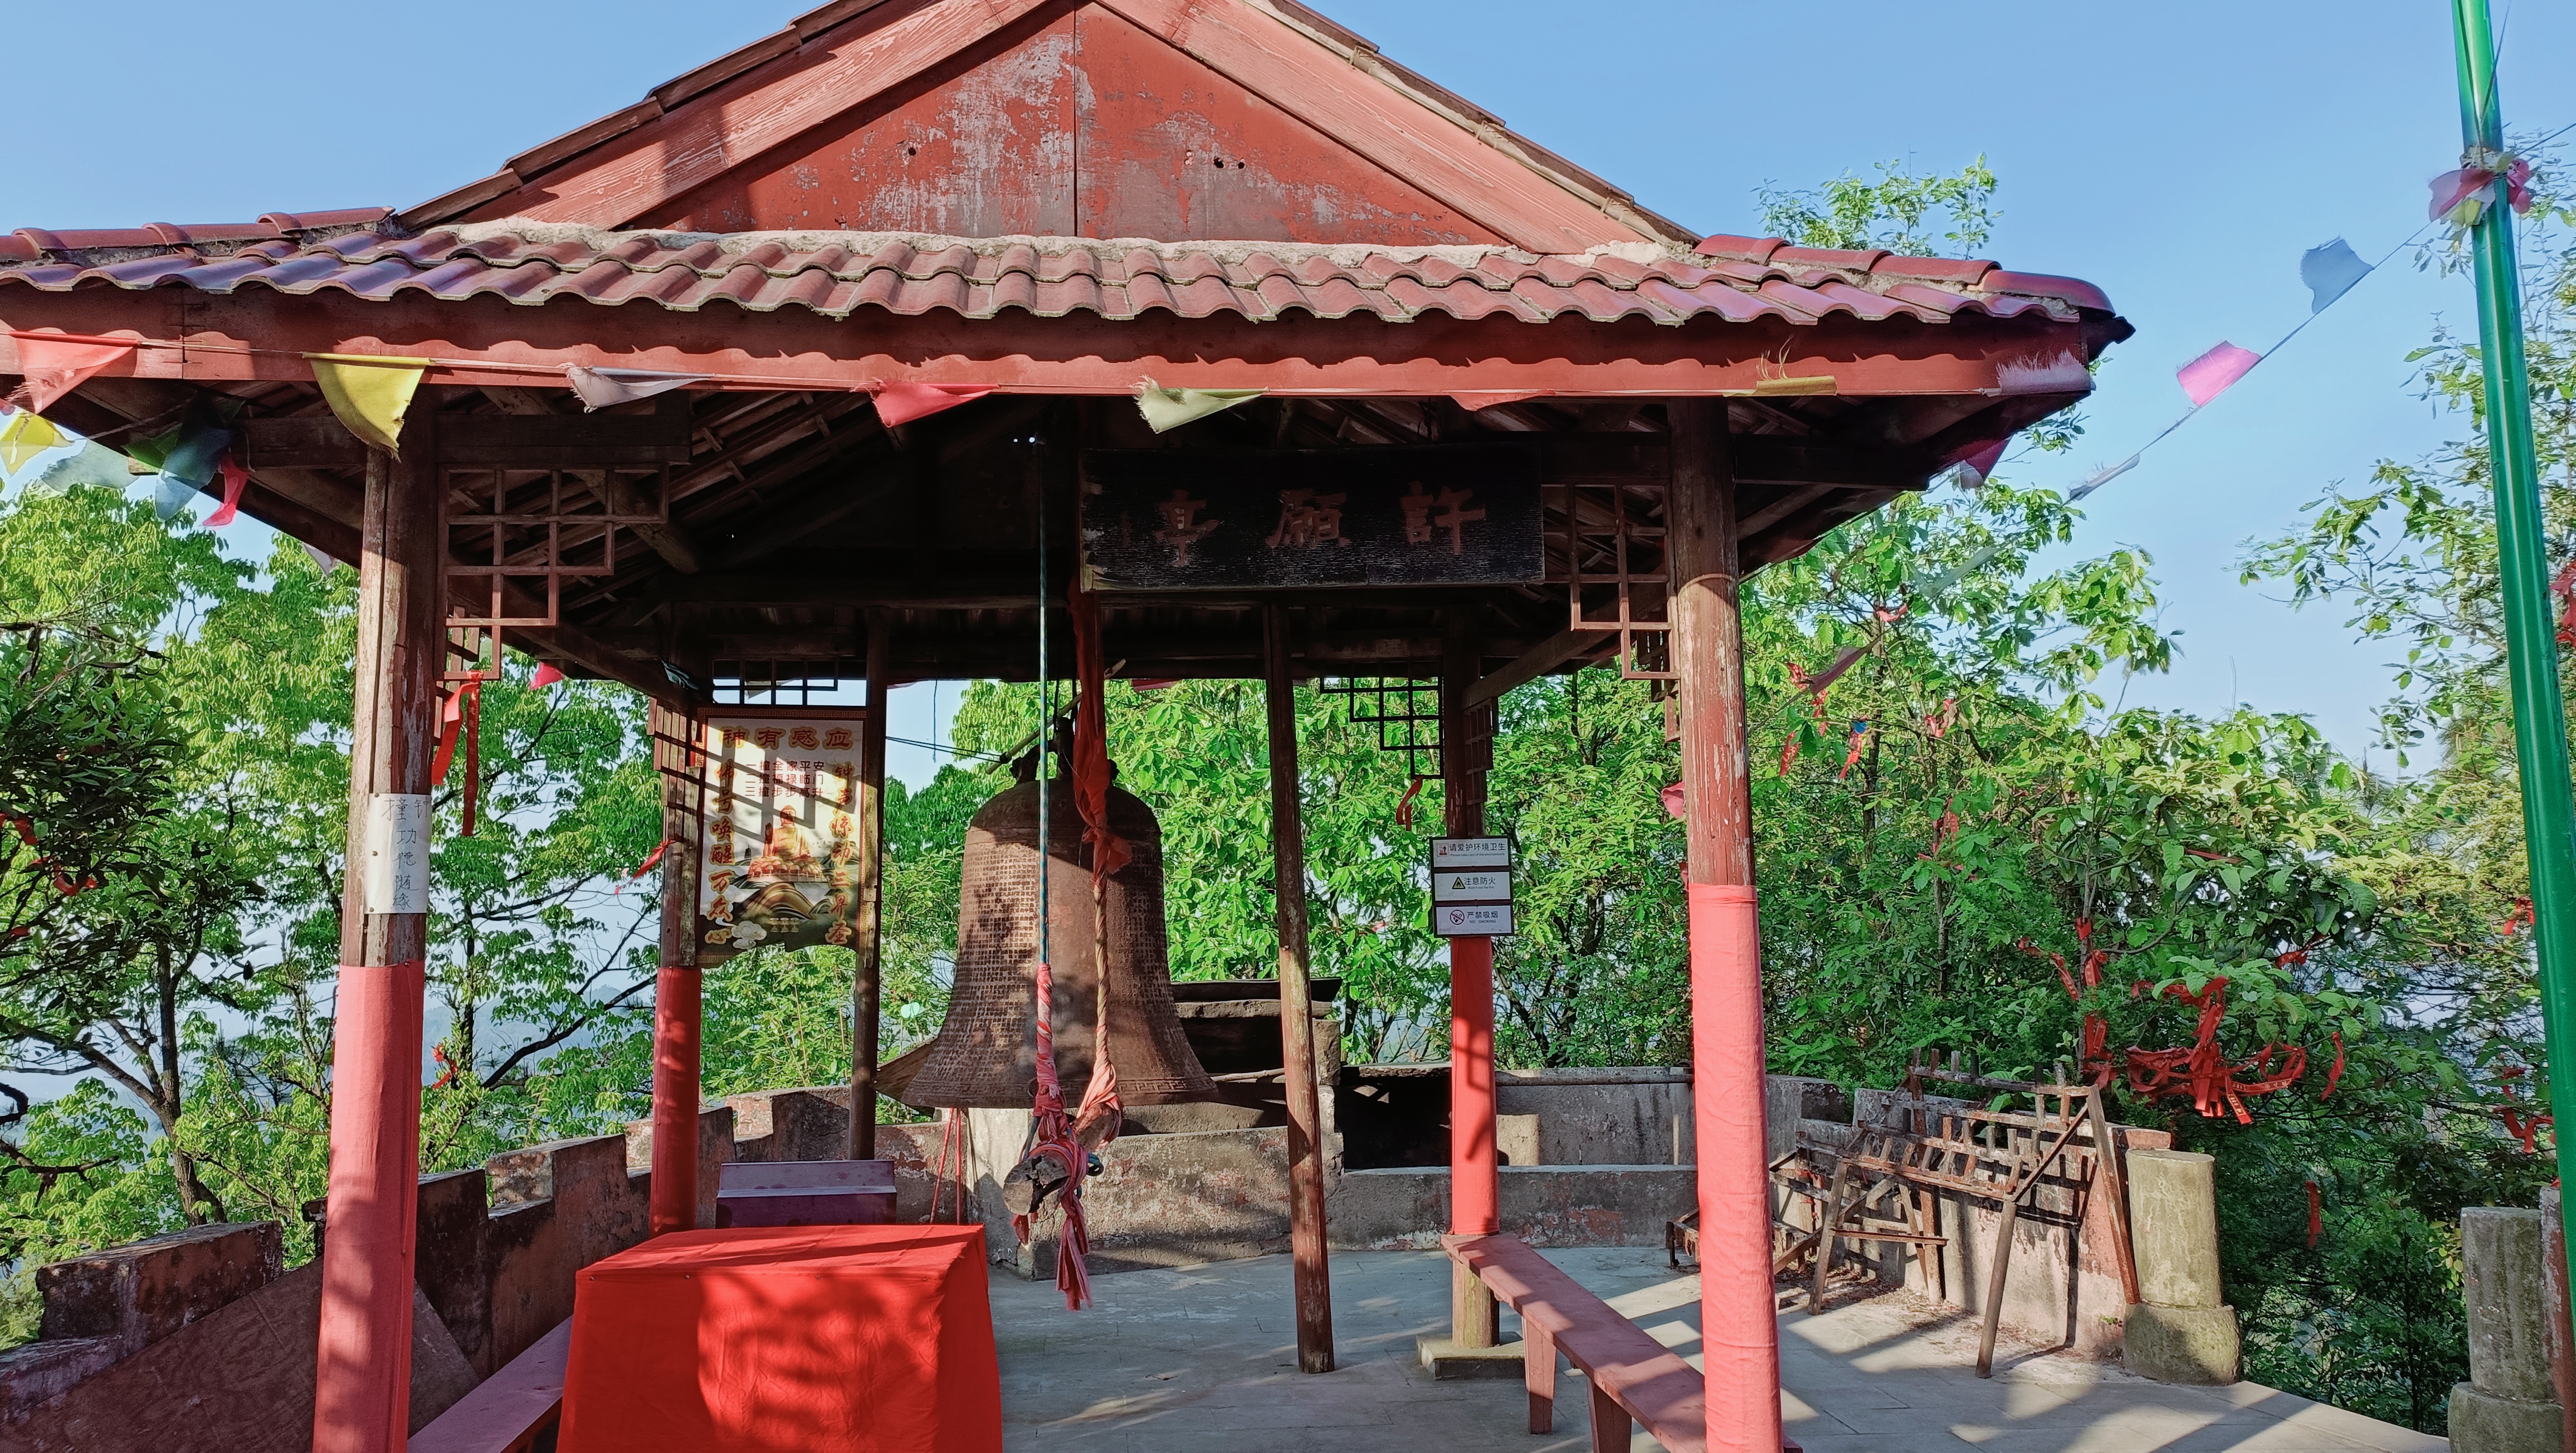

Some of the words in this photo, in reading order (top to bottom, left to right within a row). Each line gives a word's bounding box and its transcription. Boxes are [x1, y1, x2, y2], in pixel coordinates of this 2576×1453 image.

[723, 728, 853, 748] 神有感应
[746, 760, 824, 772] 一撞全家平安
[745, 773, 823, 785] 二撞福禄临门
[745, 786, 823, 797] 三撞步步高升
[708, 760, 736, 943] 佛号唤醒万众心
[828, 760, 851, 943] 钟声惊动三界圣
[1449, 843, 1506, 852] 请爱护环境卫生
[391, 827, 419, 910] 功德随缘
[1463, 876, 1496, 885] 注意防火
